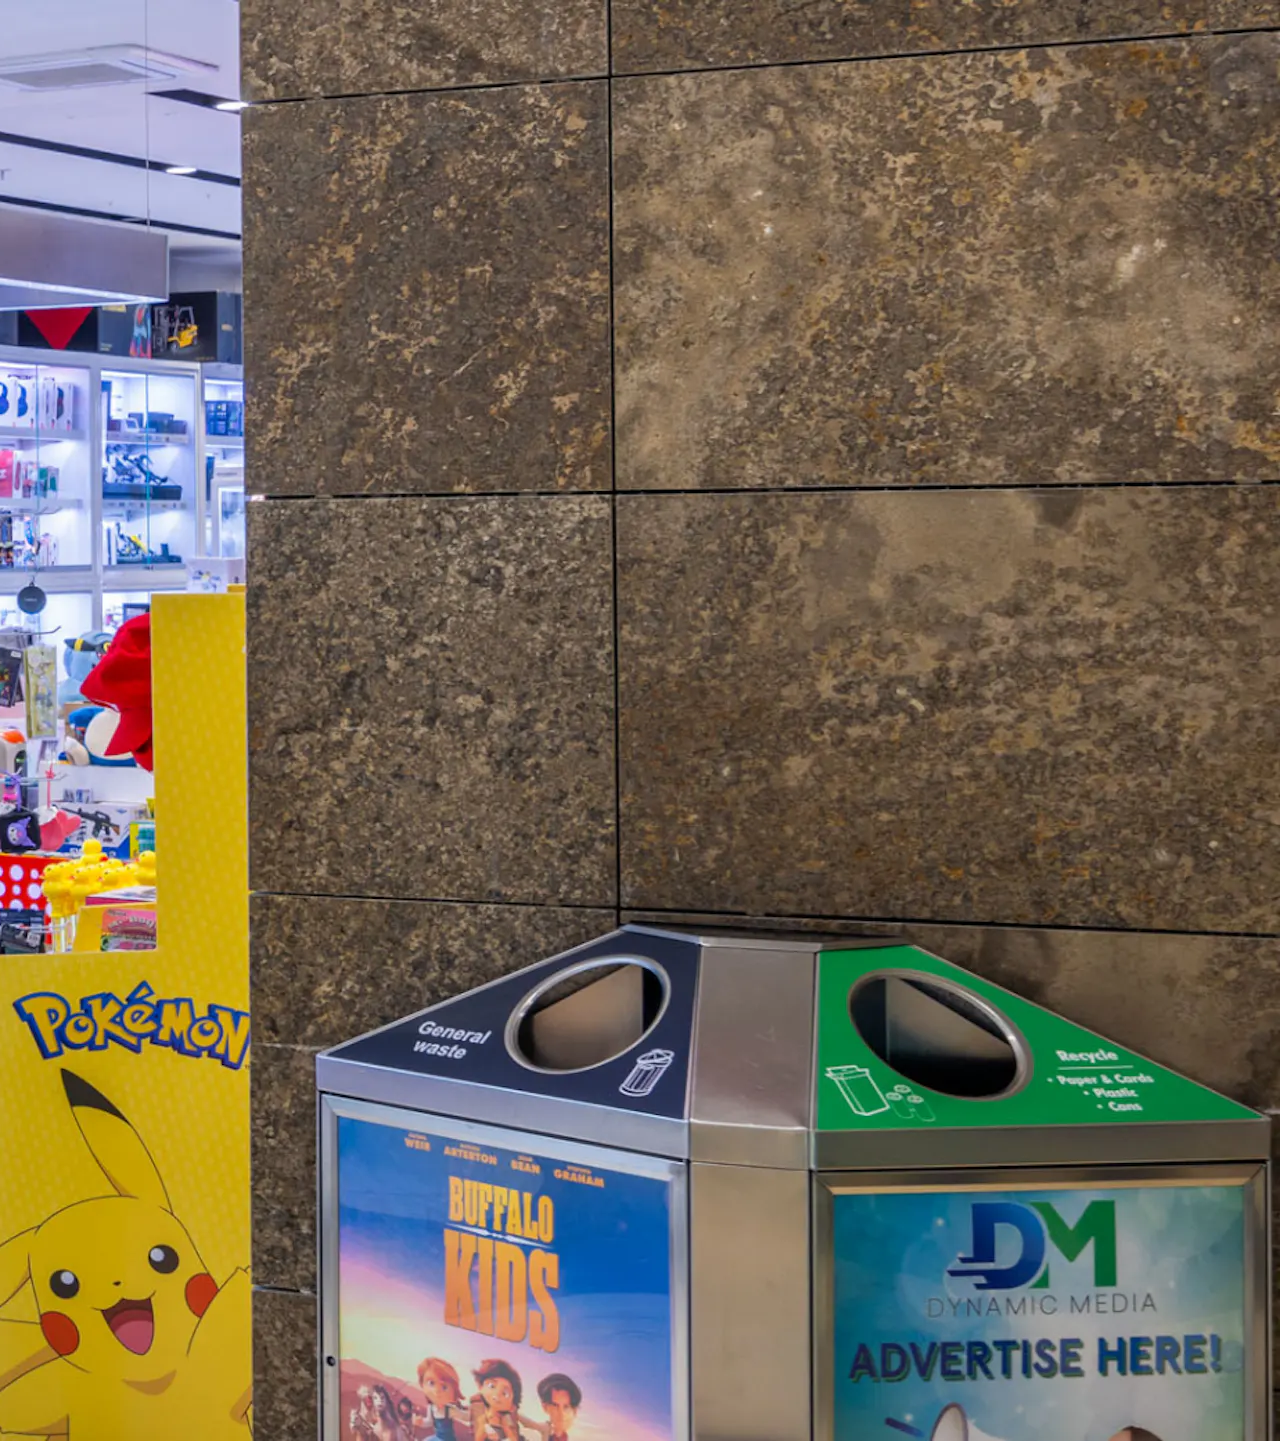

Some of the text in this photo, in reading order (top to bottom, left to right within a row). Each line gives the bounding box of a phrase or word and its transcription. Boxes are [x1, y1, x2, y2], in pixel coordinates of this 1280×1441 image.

[418, 1020, 491, 1046] General
[413, 1037, 467, 1060] waste
[1055, 1048, 1119, 1064] Recycle
[1056, 1072, 1155, 1087] Paper & Cards
[1092, 1087, 1139, 1098] Plastic
[1108, 1101, 1143, 1112] Cans
[404, 1137, 431, 1152] WEIR
[444, 1146, 498, 1166] ARTERTON
[510, 1159, 540, 1174] BEAN
[553, 1169, 605, 1188] GRAHAM
[448, 1175, 554, 1244] BUFFALO
[946, 1200, 1117, 1290] DM
[443, 1228, 559, 1354] KIDS
[927, 1292, 1157, 1319] DYNAMIC MEDIA
[848, 1333, 1222, 1383] ADVERTISE HERE!
